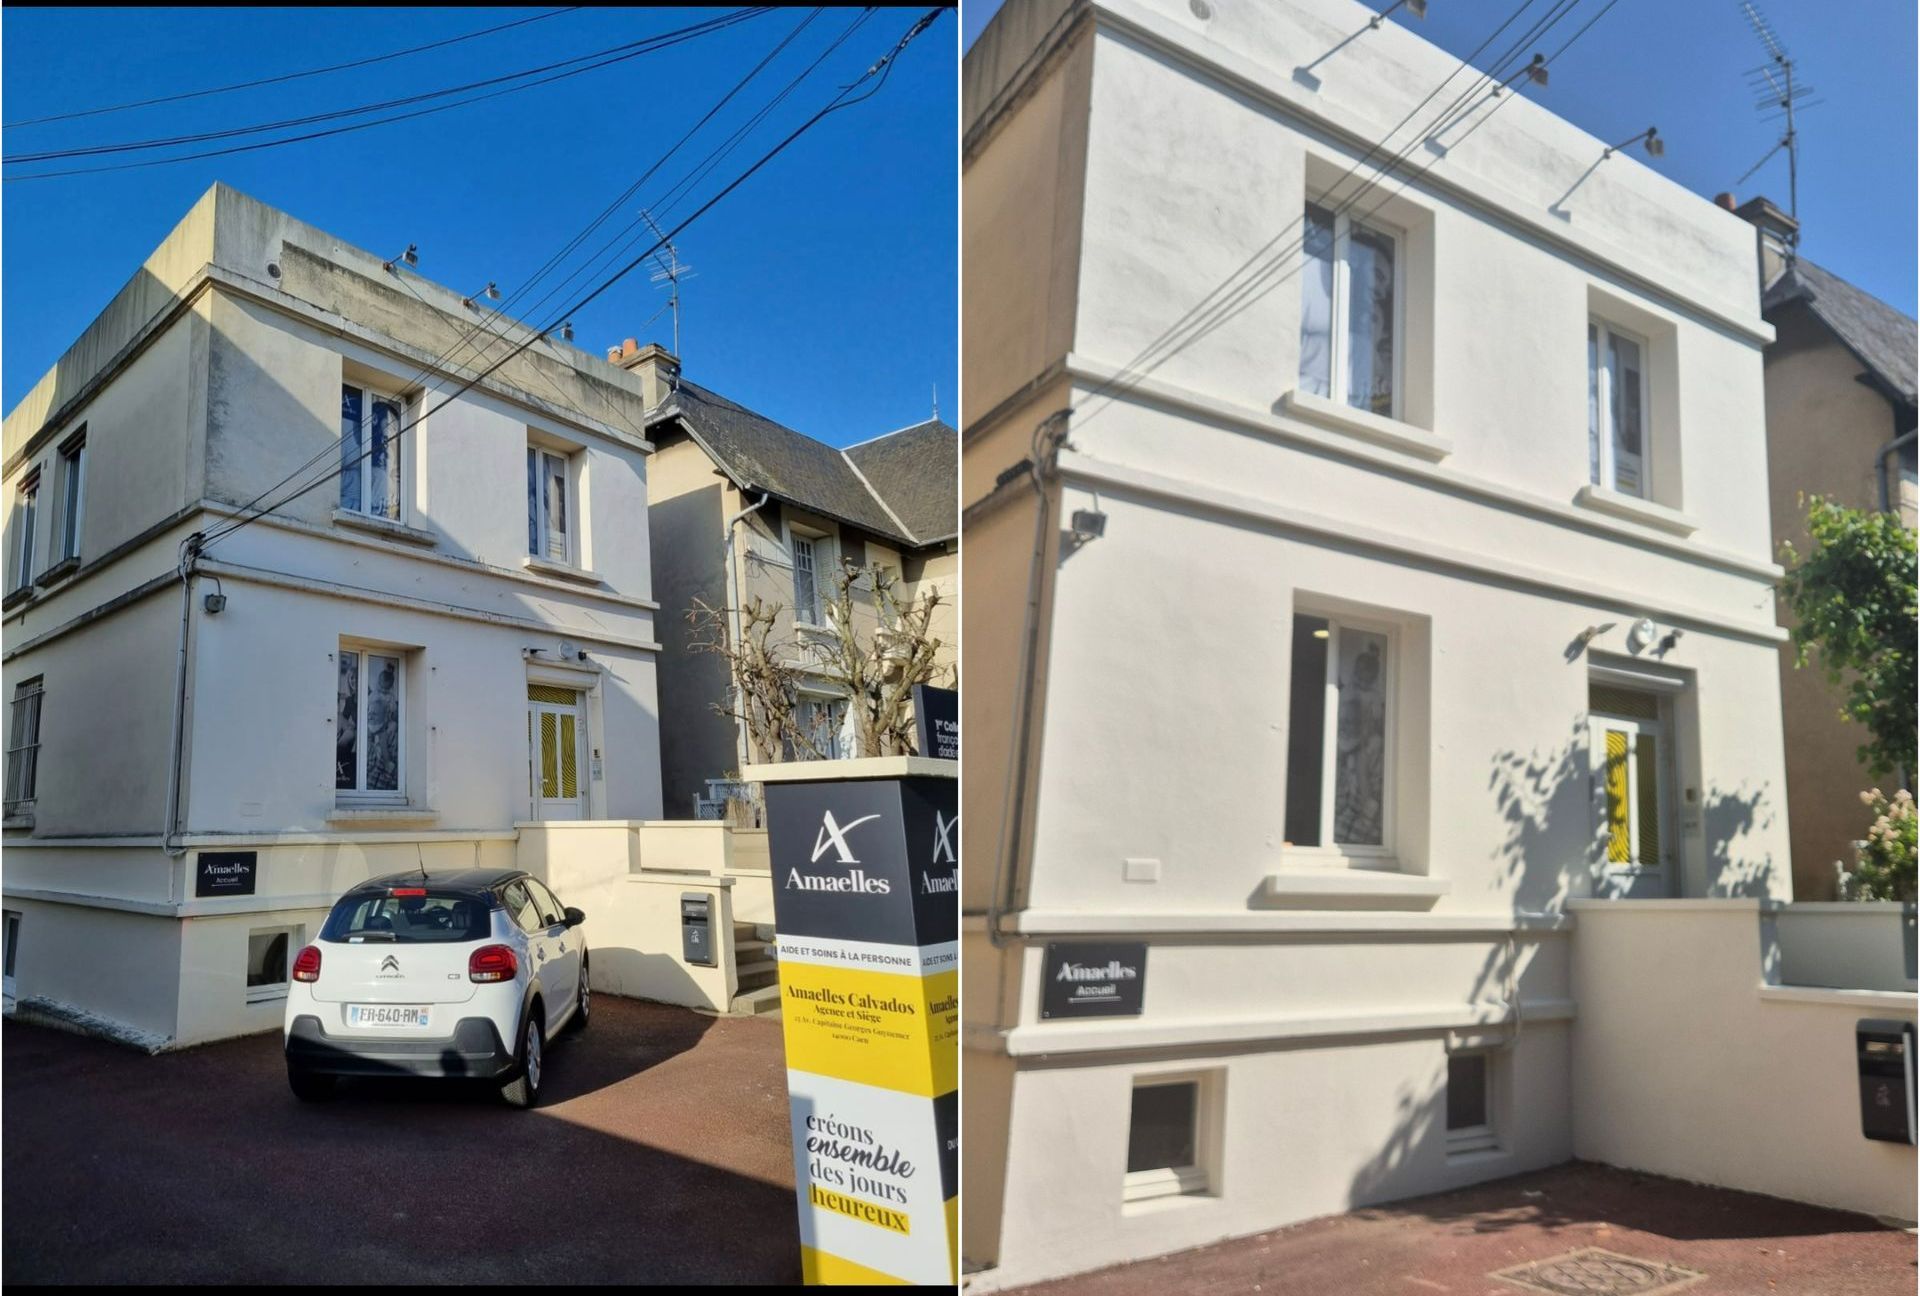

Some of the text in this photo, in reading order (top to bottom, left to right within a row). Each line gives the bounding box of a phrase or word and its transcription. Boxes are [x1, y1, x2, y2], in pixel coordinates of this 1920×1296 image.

[203, 863, 250, 874] Amaelles
[784, 867, 891, 894] Amaelles
[781, 945, 912, 967] AIDE ET SOINS À LA PERSONNE
[1056, 960, 1137, 982] Amaelles
[786, 985, 915, 1015] Amaelles Calvados
[814, 1004, 882, 1023] Agence et Siège
[806, 1113, 874, 1146] créons
[806, 1135, 916, 1178] ensemble
[810, 1157, 908, 1204] des jours
[810, 1182, 907, 1233] heureux
